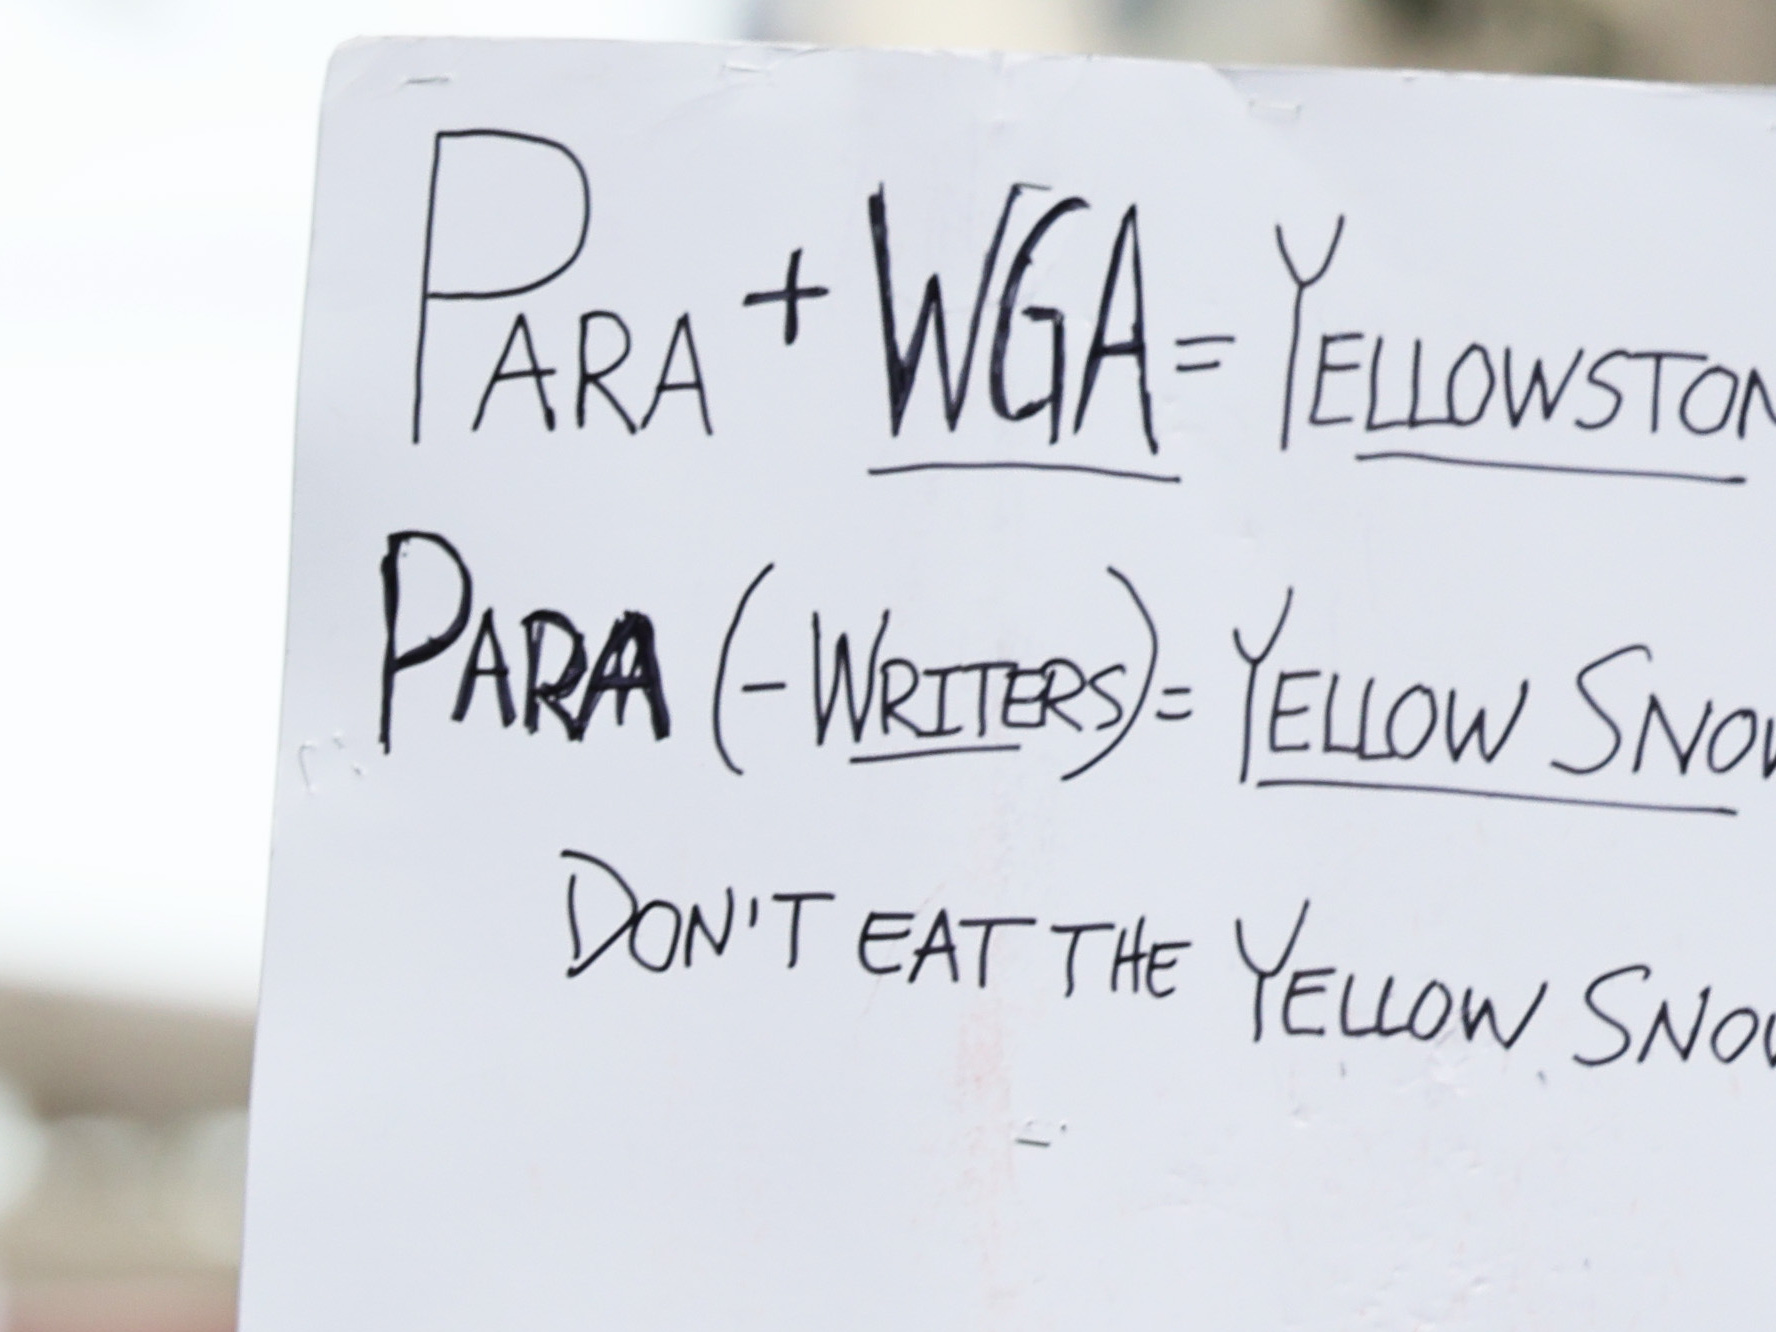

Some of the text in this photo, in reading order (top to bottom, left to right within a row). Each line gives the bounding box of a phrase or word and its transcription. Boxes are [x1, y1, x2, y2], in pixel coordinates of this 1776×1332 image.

[411, 128, 714, 446] PARA
[378, 530, 672, 757] PARA
[1232, 587, 1531, 782] YELLOW
[559, 848, 836, 979] DON'T
[857, 908, 1038, 990] EAT
[1048, 915, 1193, 1000] THE
[1234, 899, 1550, 1046] YELLOW
